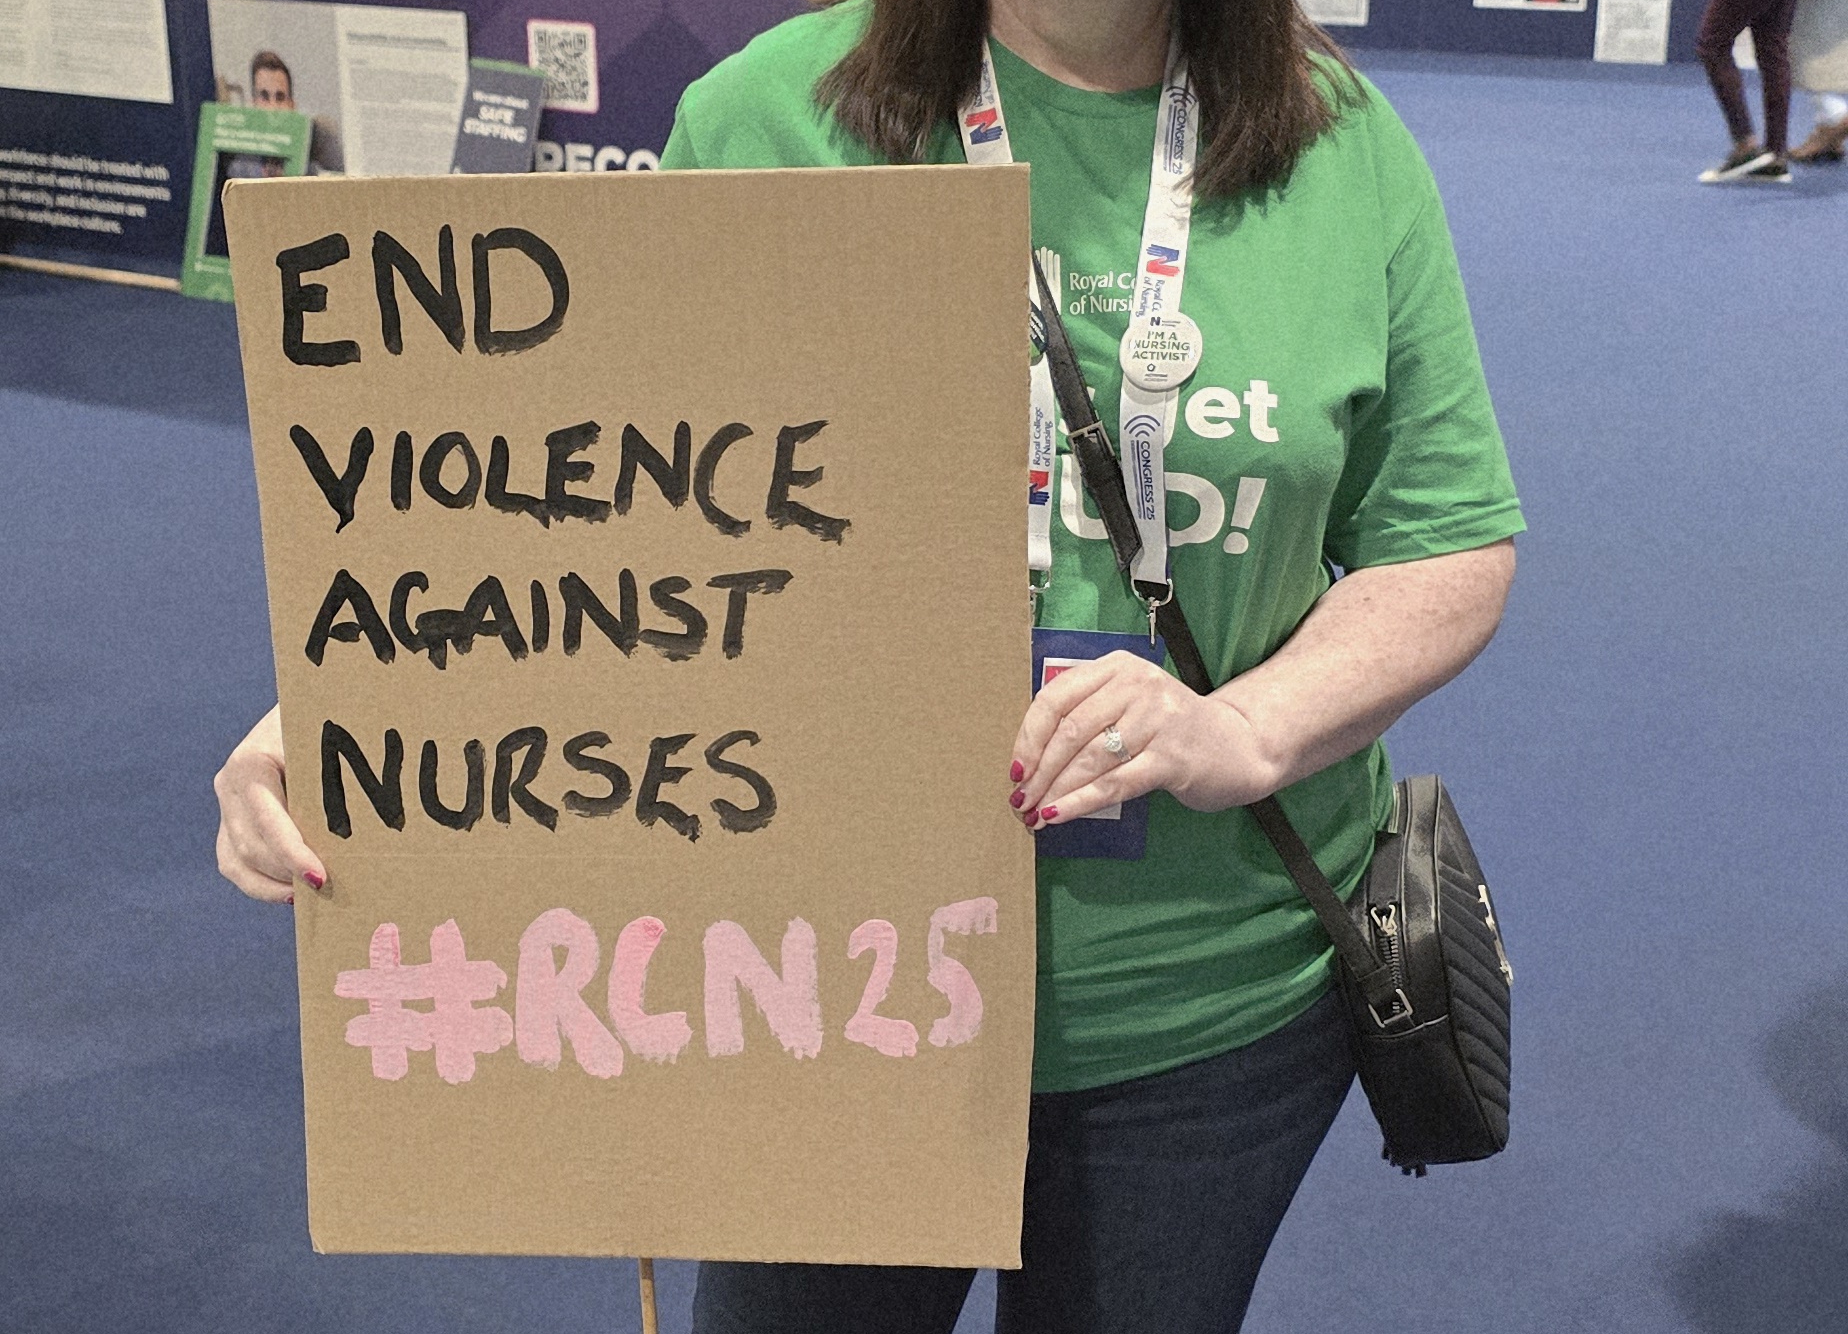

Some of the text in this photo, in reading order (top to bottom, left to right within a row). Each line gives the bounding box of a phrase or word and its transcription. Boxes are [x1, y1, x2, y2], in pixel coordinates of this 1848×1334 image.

[1174, 108, 1187, 161] CONGRESS
[276, 225, 570, 366] END
[1070, 271, 1114, 295] Royal
[1070, 295, 1134, 315] of Nursi
[1132, 350, 1189, 361] ACTIVIST
[1134, 339, 1190, 351] NURSING
[1147, 330, 1178, 340] I'M A
[1033, 406, 1044, 466] Royal College
[1042, 420, 1054, 467] of Nursing
[1164, 380, 1279, 452] et
[290, 420, 851, 544] VIOLENCE
[1141, 441, 1155, 503] CONGRESS
[305, 569, 794, 669] AGAINST
[321, 720, 778, 841] NURSES
[334, 897, 999, 1085] #RCN25
